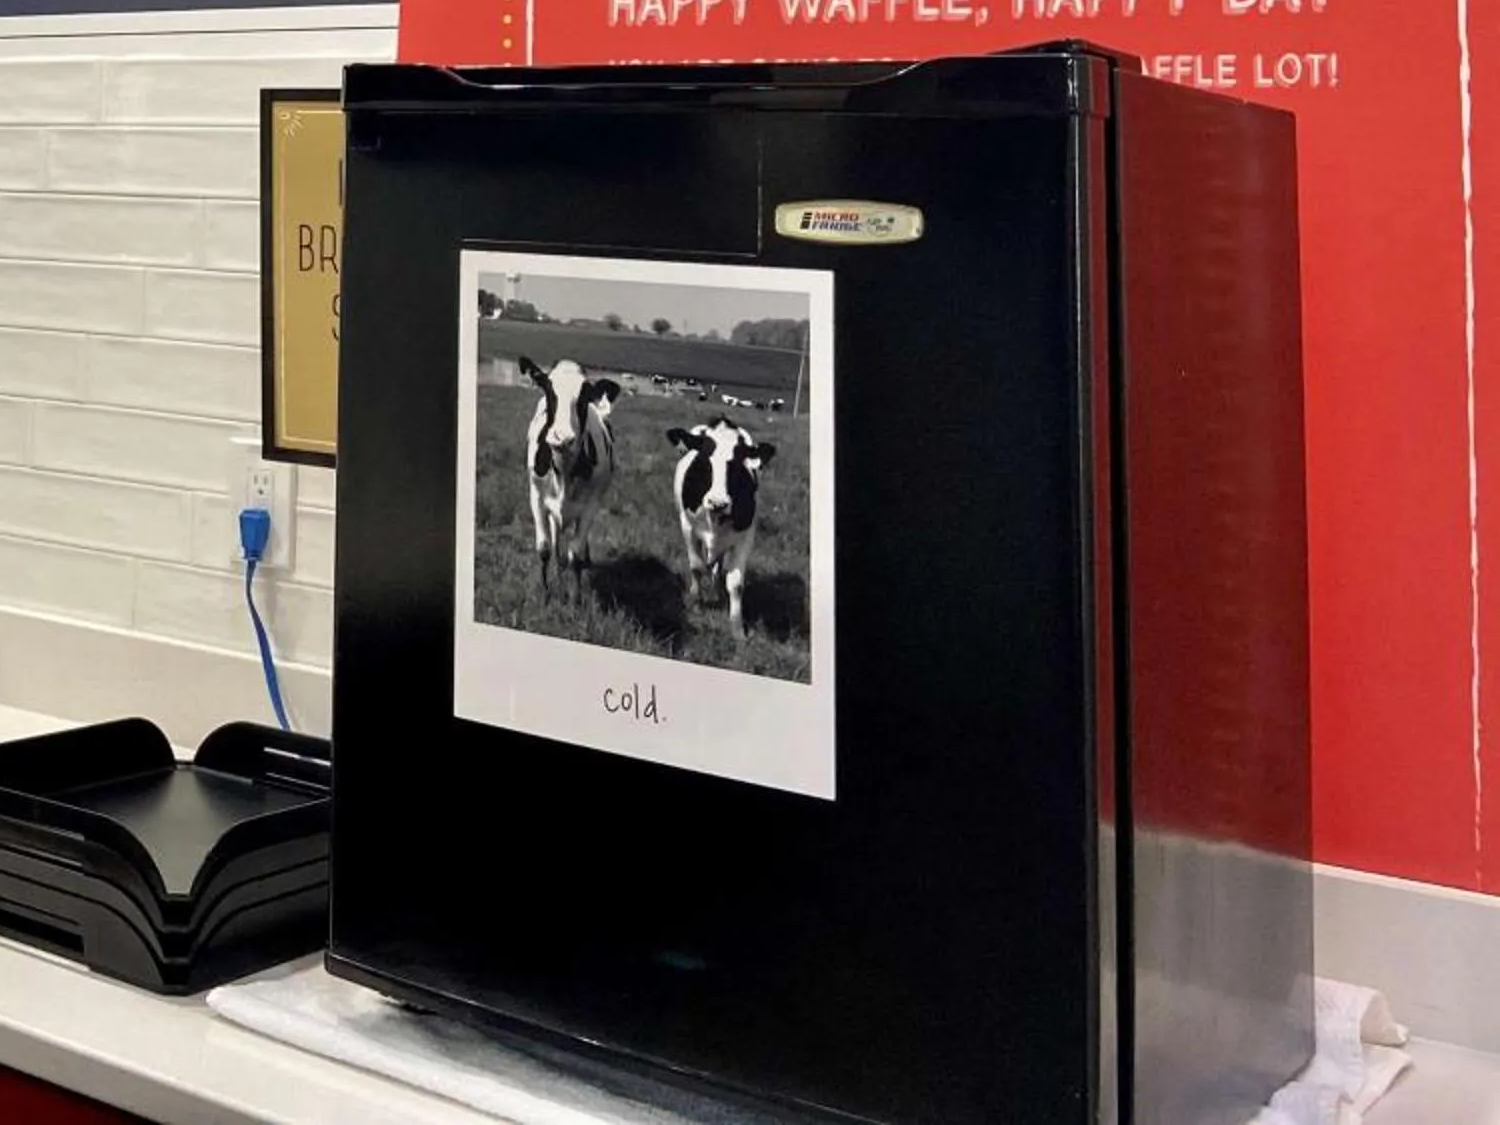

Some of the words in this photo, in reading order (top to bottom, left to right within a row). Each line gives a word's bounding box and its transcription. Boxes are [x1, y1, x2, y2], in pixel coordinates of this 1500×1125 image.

[1141, 54, 1237, 88] FFLE
[1254, 52, 1338, 88] LOT!
[603, 683, 667, 723] cold.
